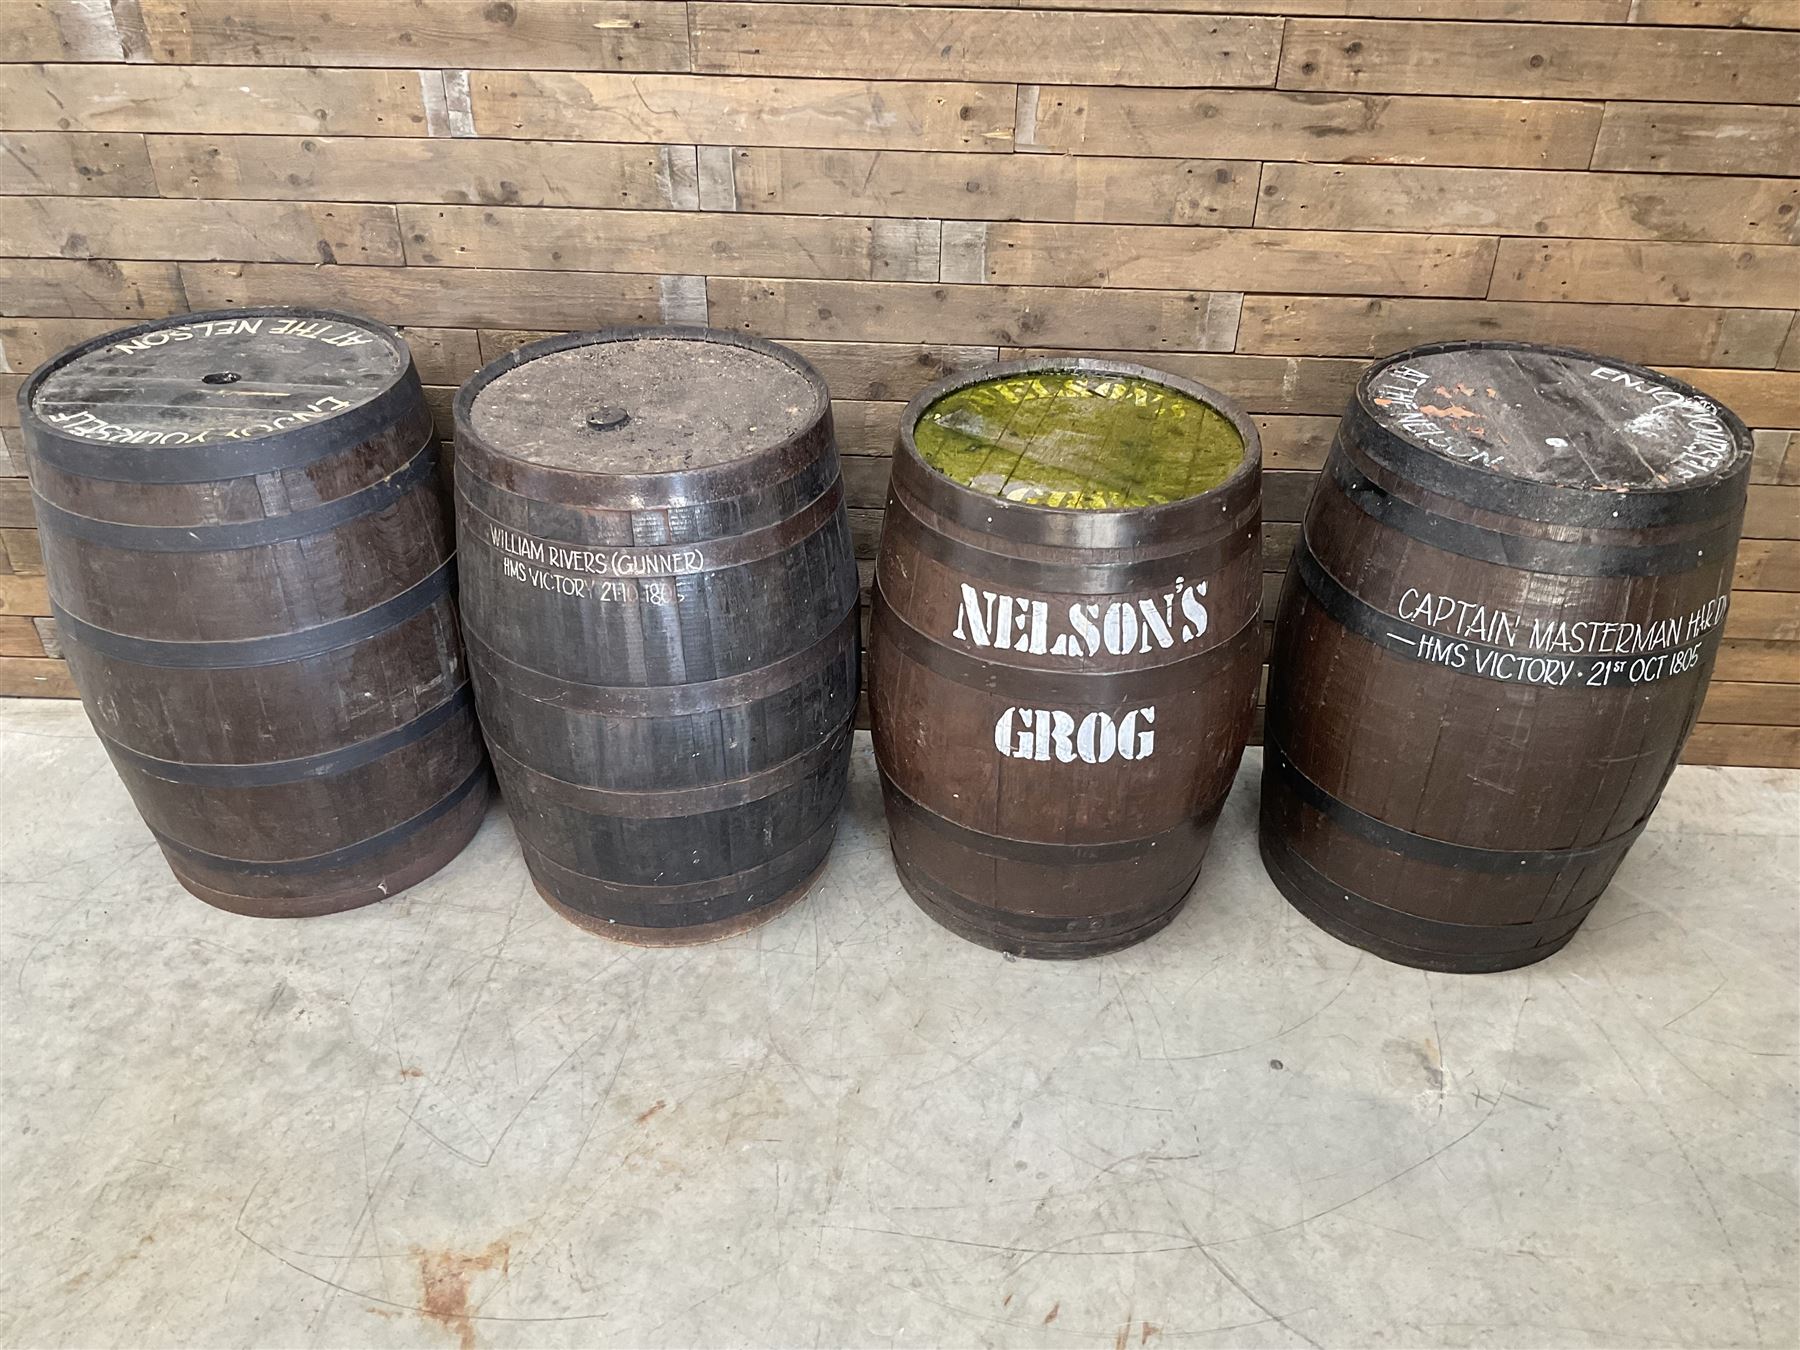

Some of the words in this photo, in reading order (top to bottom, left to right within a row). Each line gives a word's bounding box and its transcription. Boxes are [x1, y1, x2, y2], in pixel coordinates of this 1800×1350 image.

[114, 319, 263, 355] NELSON
[268, 319, 333, 339] THE
[321, 330, 373, 348] AT
[489, 523, 545, 563] WILLIAM
[549, 546, 607, 574] RIVERS
[611, 549, 704, 576] (GUNNER)
[503, 557, 527, 582] HMS
[529, 568, 595, 599] VICTORY
[952, 576, 1209, 657] NELSON'S
[1398, 588, 1520, 647] CAPTAIN
[1529, 617, 1683, 654] MASTERMAN
[1686, 594, 1727, 641] HARD
[1417, 634, 1468, 668] HMS
[1474, 647, 1575, 687] VICTORY
[1628, 655, 1670, 683] OCT
[1669, 642, 1703, 676] 1805
[994, 705, 1155, 764] GROG
